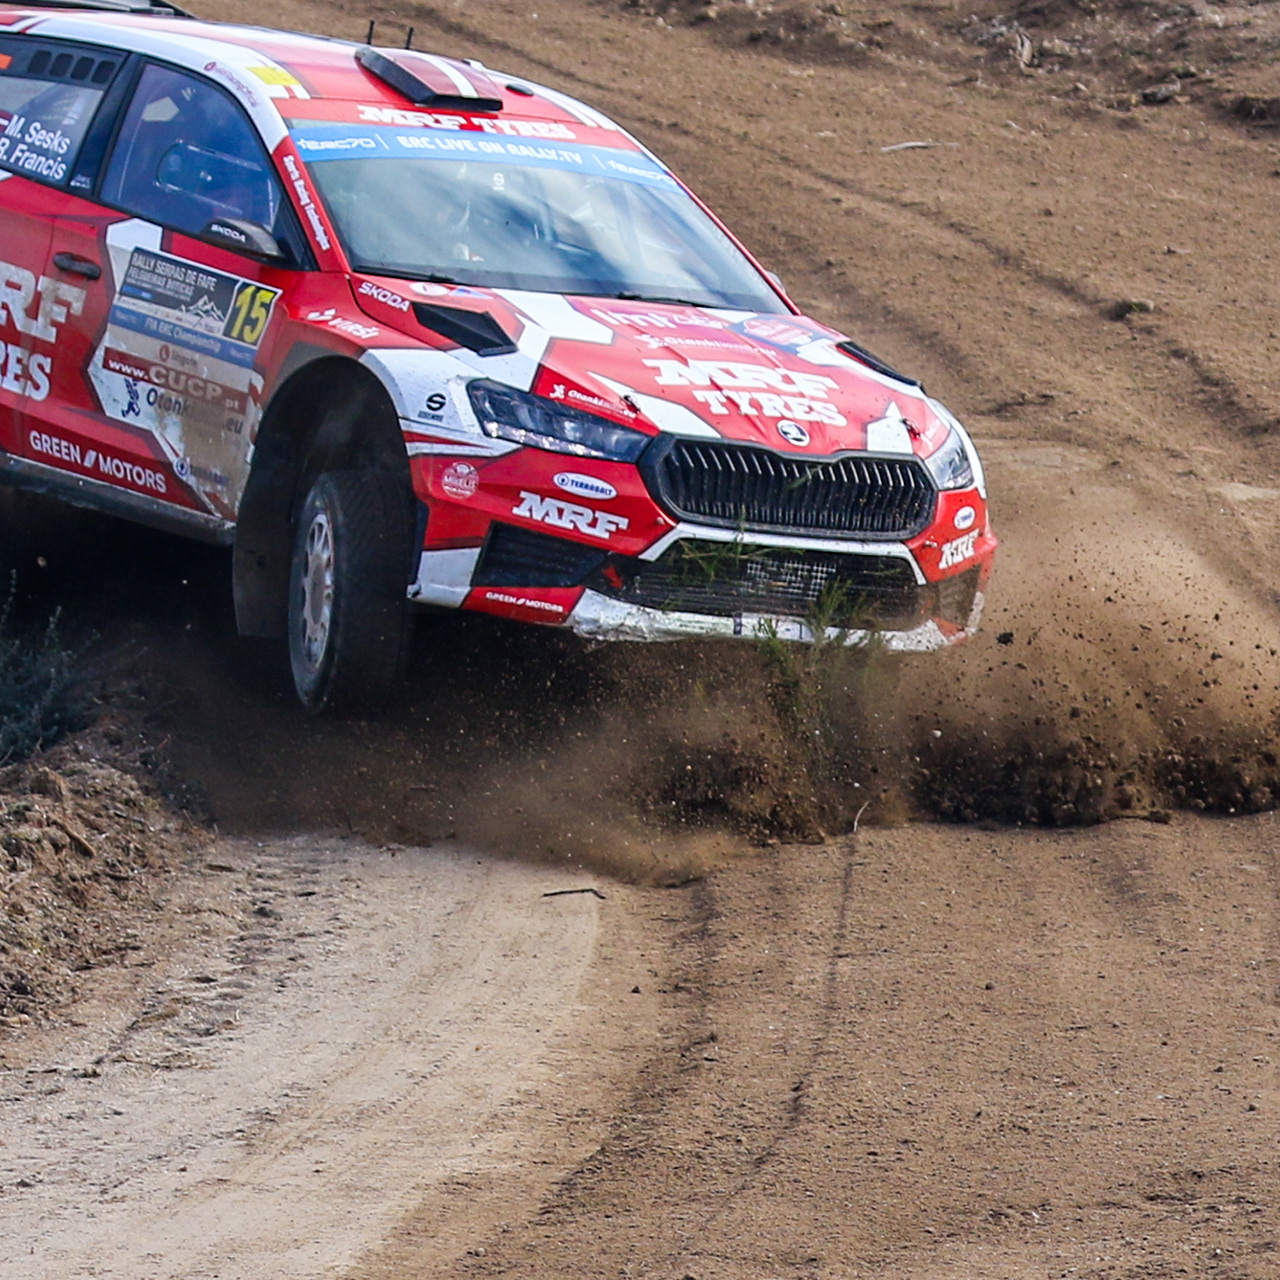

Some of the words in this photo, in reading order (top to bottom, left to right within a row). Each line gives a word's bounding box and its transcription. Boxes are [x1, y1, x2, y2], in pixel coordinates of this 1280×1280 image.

[4, 114, 25, 139] M.
[24, 121, 71, 155] Sesks
[356, 105, 468, 131] MRF
[470, 117, 577, 140] TYRES
[9, 143, 67, 180] Francis
[396, 135, 436, 150] ERC
[434, 137, 479, 153] LIVE
[477, 140, 506, 155] ON
[505, 143, 584, 165] RALLY.TV
[158, 321, 173, 337] ERC
[230, 285, 275, 344] 15
[641, 358, 840, 399] MRF
[691, 390, 849, 427] TYRES
[29, 430, 82, 465] GREEN
[98, 453, 167, 493] MOTORS
[512, 490, 629, 539] MRF
[938, 528, 981, 570] MRF
[485, 591, 517, 604] GREEN
[525, 599, 565, 613] MOTORS
